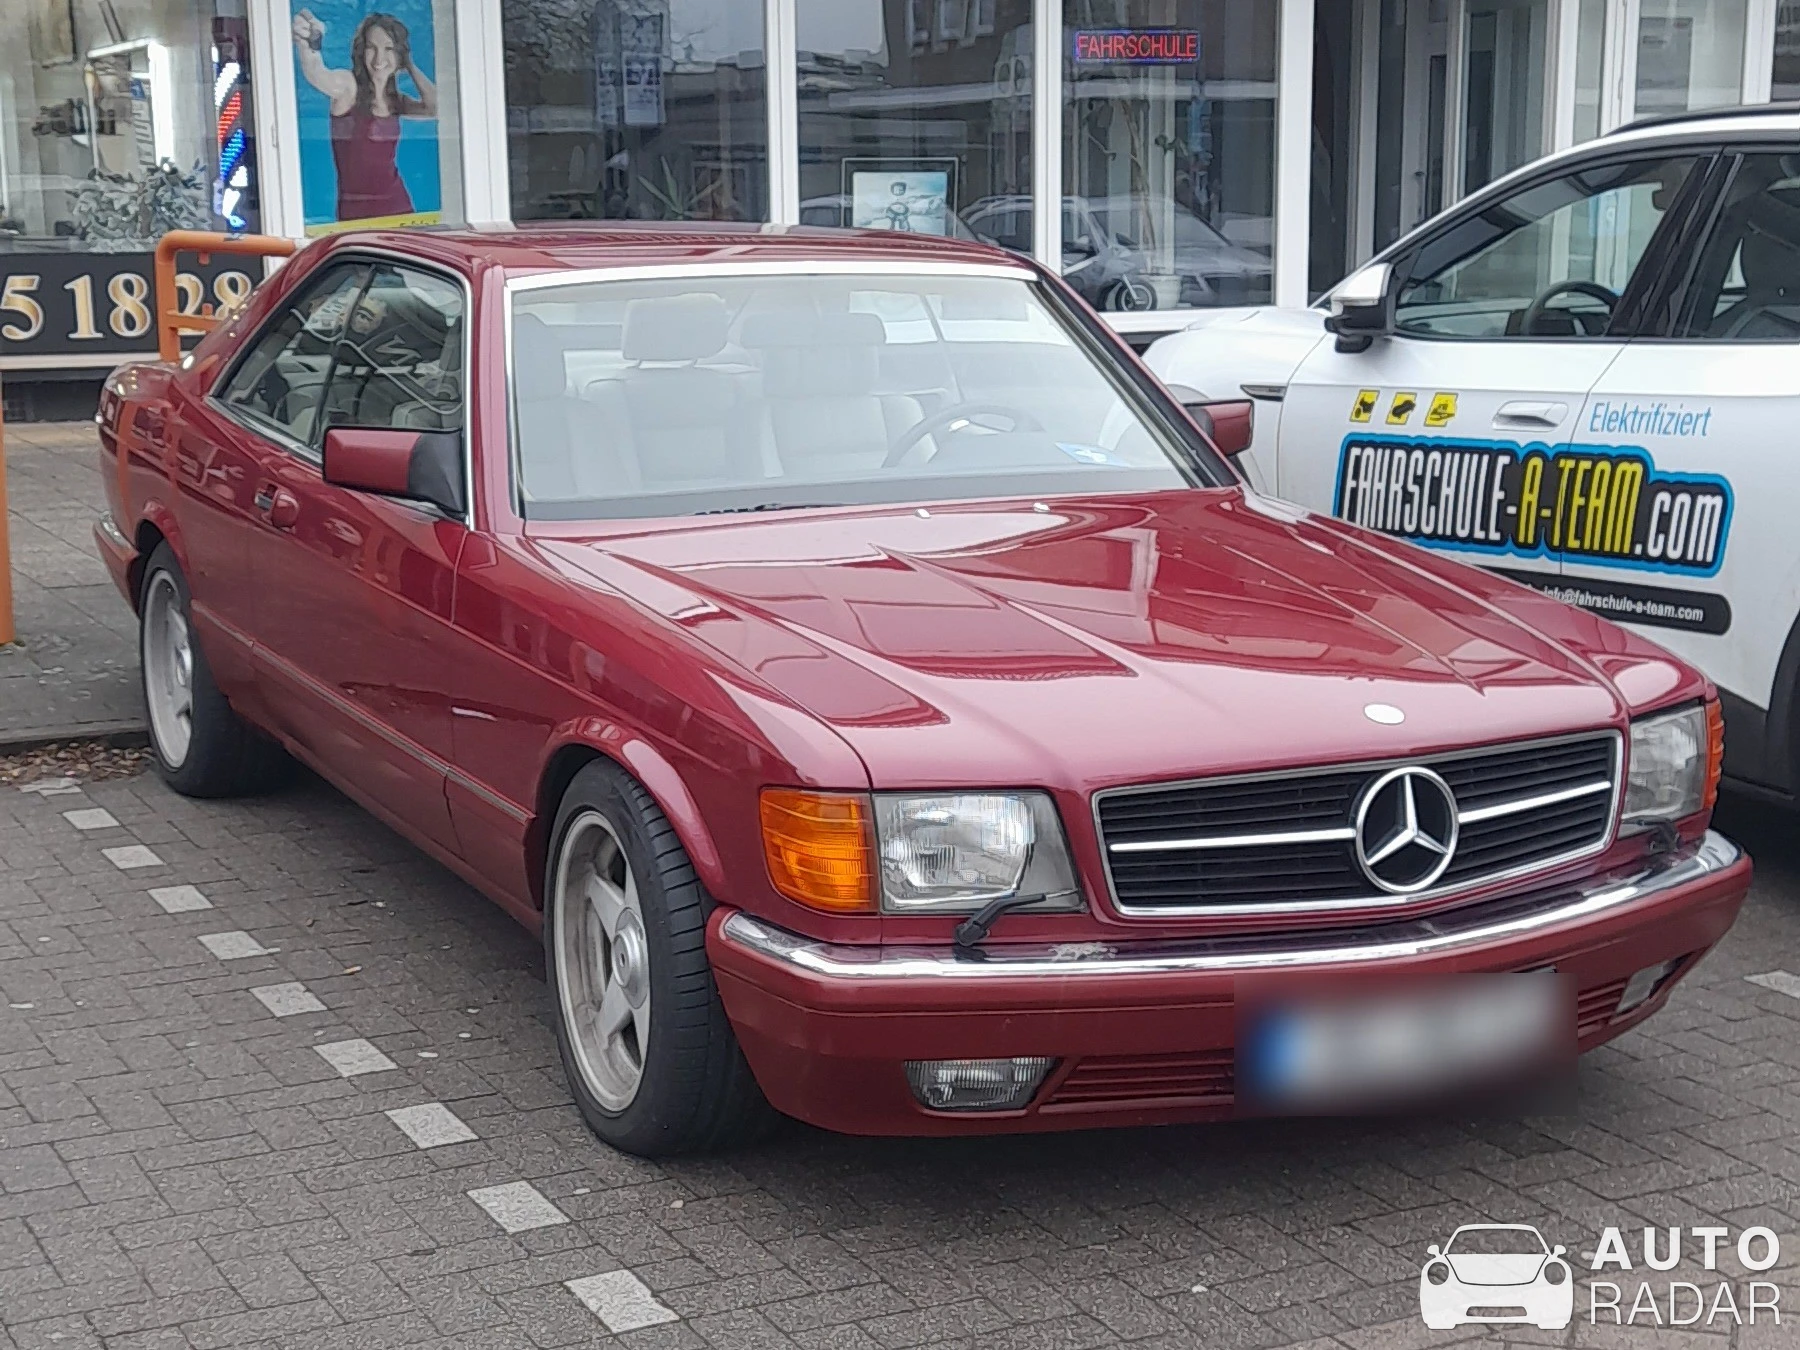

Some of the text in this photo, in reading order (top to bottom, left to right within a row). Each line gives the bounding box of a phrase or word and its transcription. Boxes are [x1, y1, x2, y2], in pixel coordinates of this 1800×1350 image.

[1078, 35, 1197, 58] FAHRSCHULE
[63, 272, 151, 339] 18
[1588, 402, 1712, 436] Elektrifiziert
